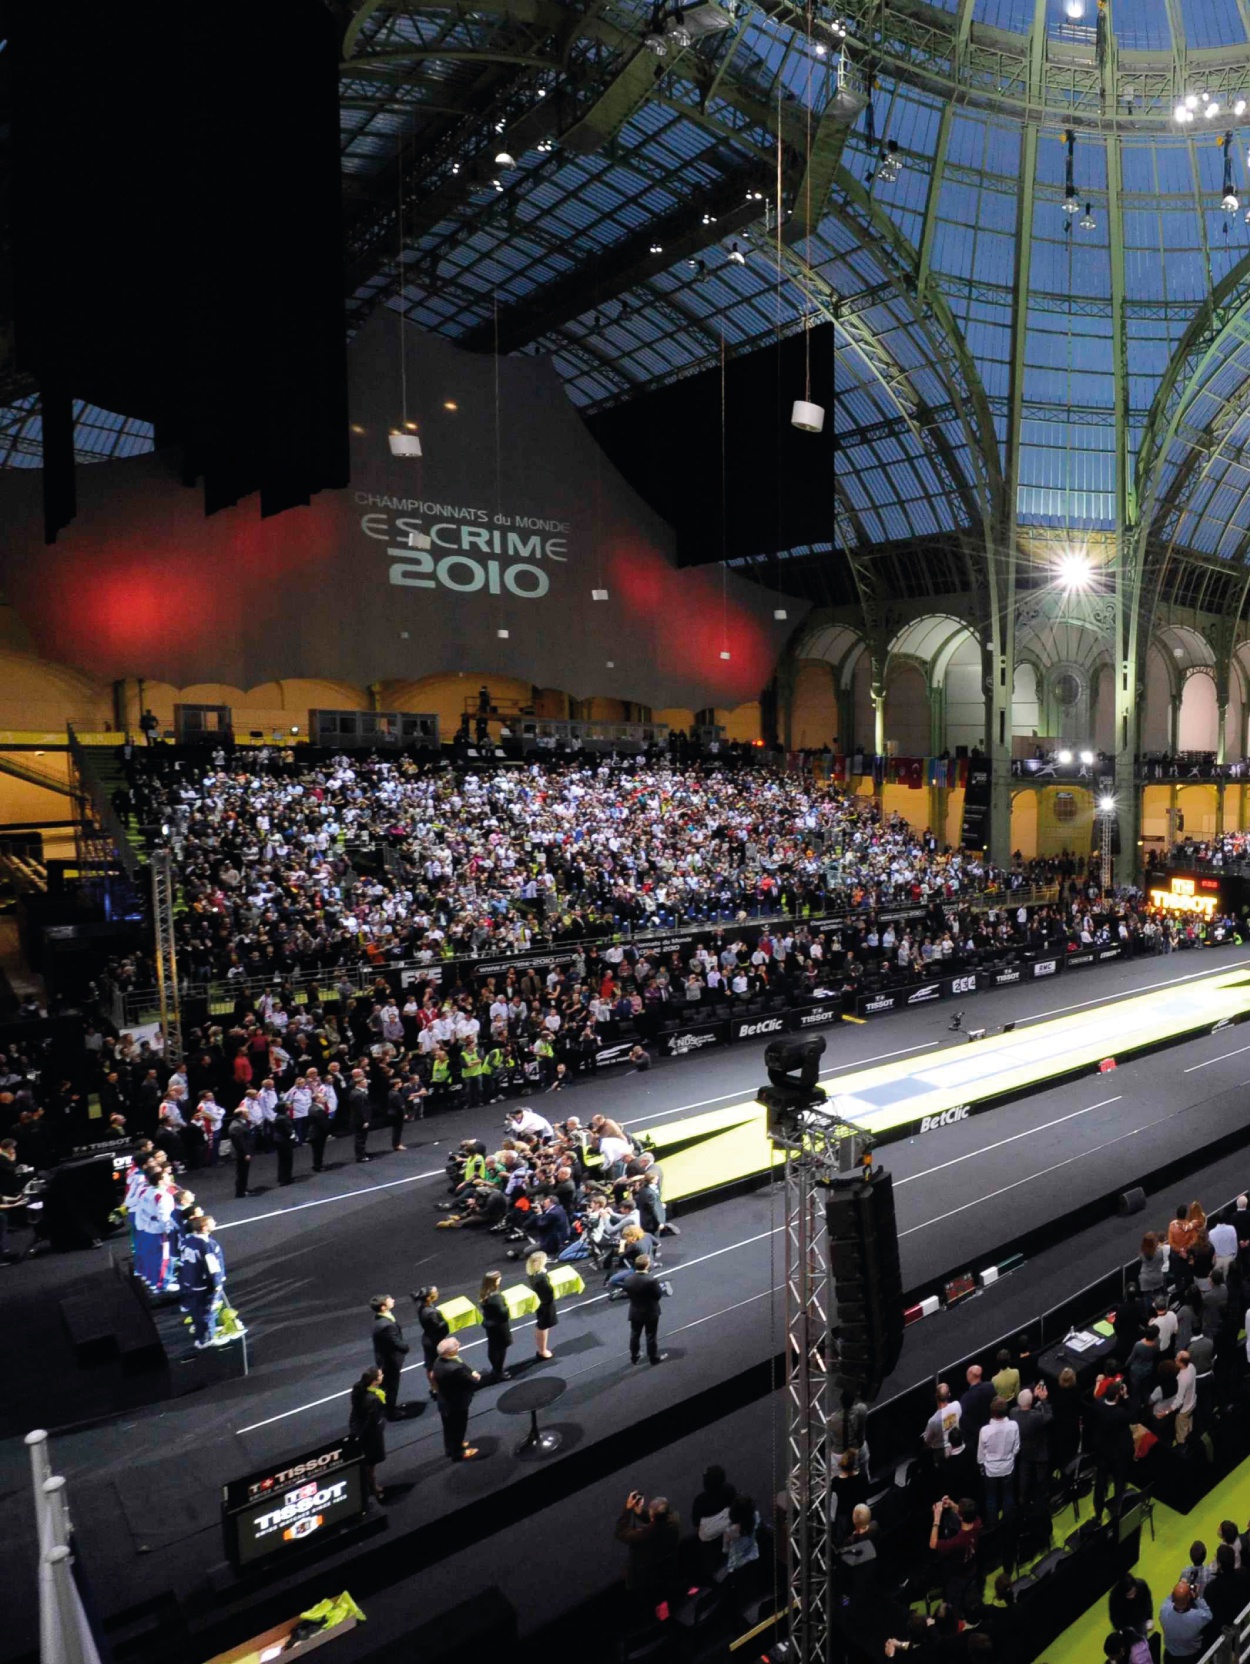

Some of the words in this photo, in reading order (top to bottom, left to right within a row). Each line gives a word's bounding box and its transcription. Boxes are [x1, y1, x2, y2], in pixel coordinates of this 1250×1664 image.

[354, 491, 488, 523] CHAMPIONNATS
[494, 512, 511, 526] du
[515, 515, 571, 534] MONDE
[361, 513, 568, 562] ESCRIME
[387, 547, 550, 599] 2010
[1151, 890, 1217, 915] TISSOT
[996, 972, 1020, 982] TISSOT
[865, 998, 895, 1010] TISSOT
[738, 1018, 783, 1038] BetClic
[800, 1011, 835, 1024] TISSOT
[920, 1105, 970, 1133] BetClic
[89, 1137, 132, 1149] TISSOT
[275, 1449, 343, 1483] TISSOT
[253, 1480, 347, 1531] TISSOT
